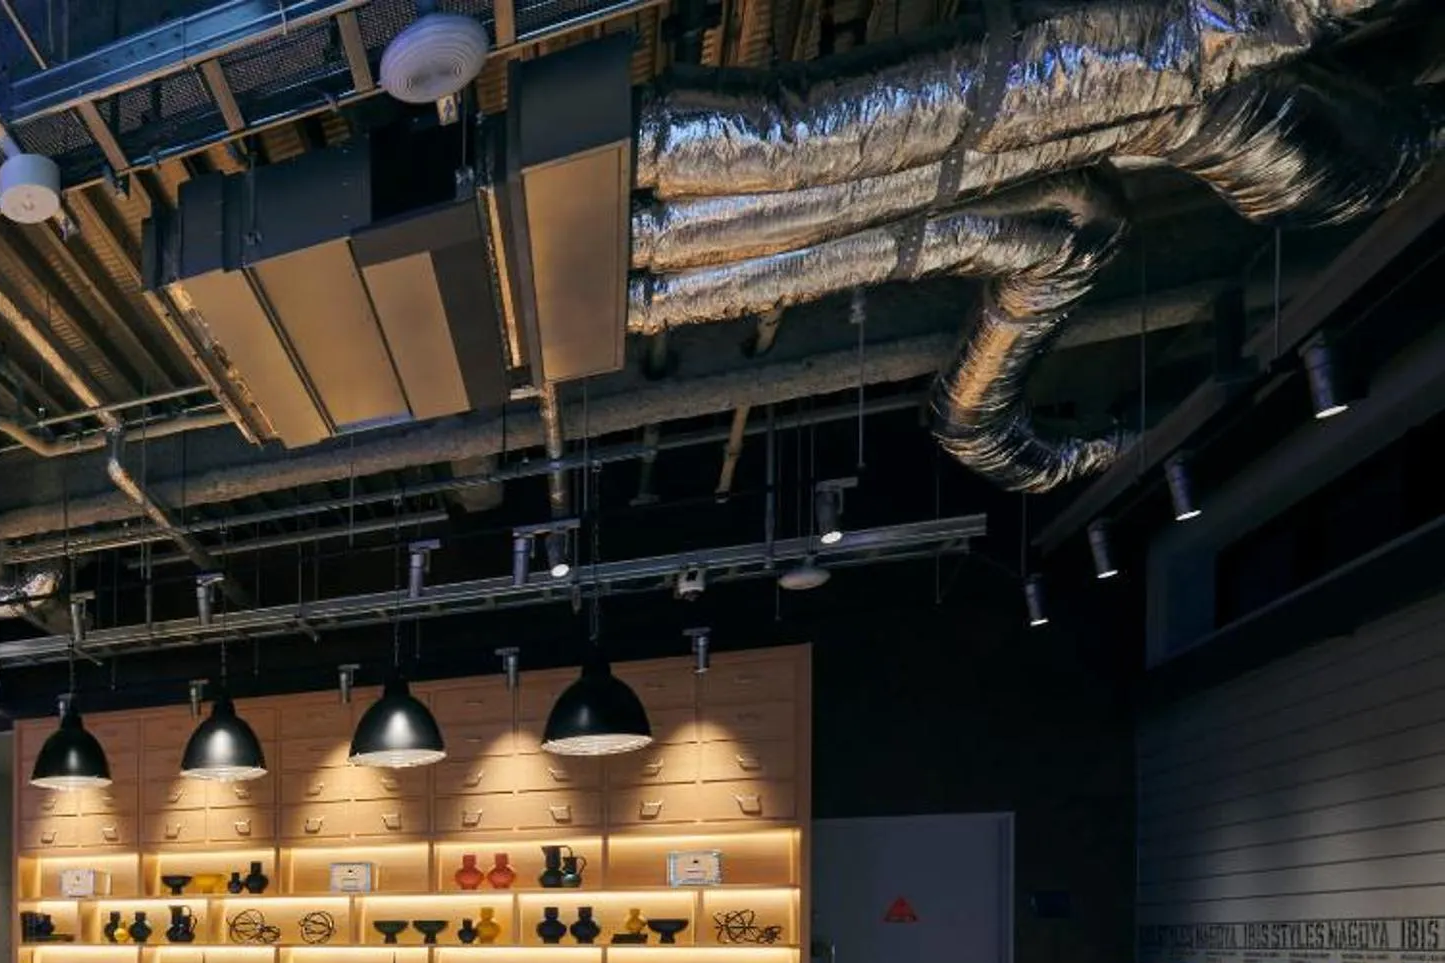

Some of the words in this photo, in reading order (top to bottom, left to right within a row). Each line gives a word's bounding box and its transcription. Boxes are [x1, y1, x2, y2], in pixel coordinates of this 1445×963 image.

[1271, 922, 1325, 949] STYLES
[1328, 920, 1390, 949] NAGOYA
[1401, 919, 1439, 949] IBIS
